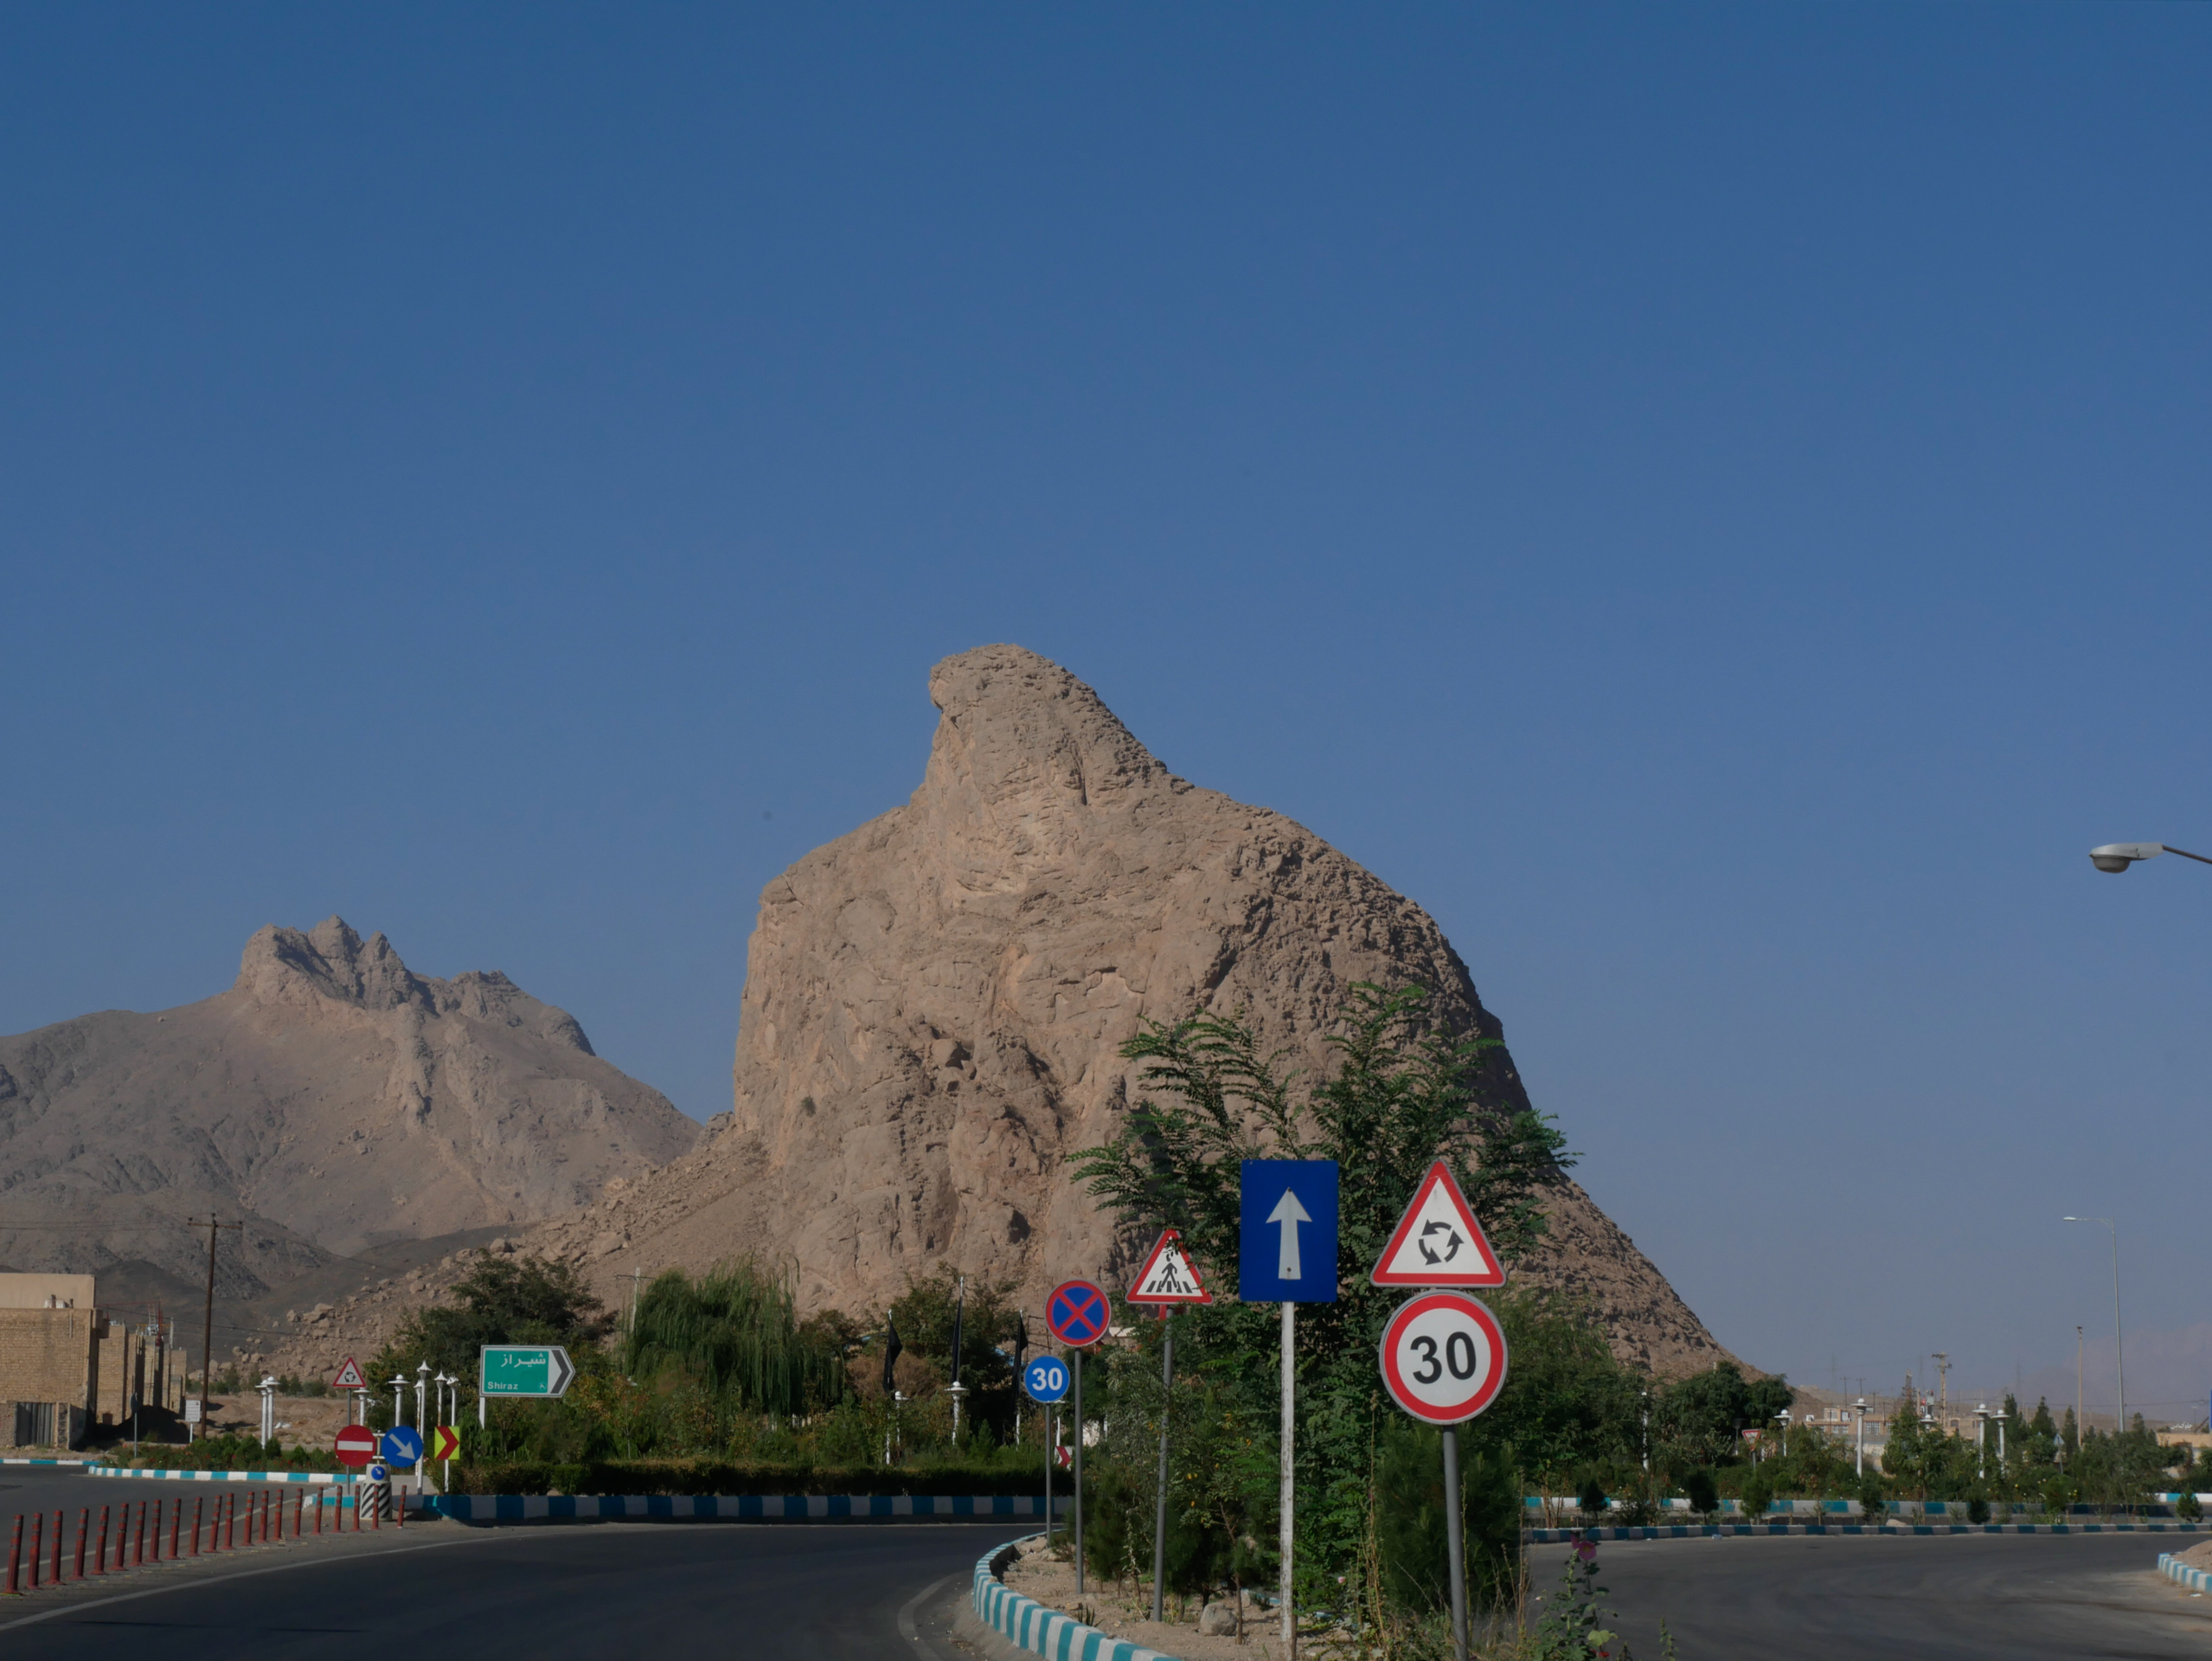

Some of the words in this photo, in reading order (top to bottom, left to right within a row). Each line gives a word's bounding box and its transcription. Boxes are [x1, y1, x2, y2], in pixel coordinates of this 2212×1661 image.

[500, 1352, 547, 1369] شیراز
[1409, 1331, 1477, 1385] 30
[487, 1381, 519, 1390] Shiraz
[1032, 1367, 1063, 1391] 30
